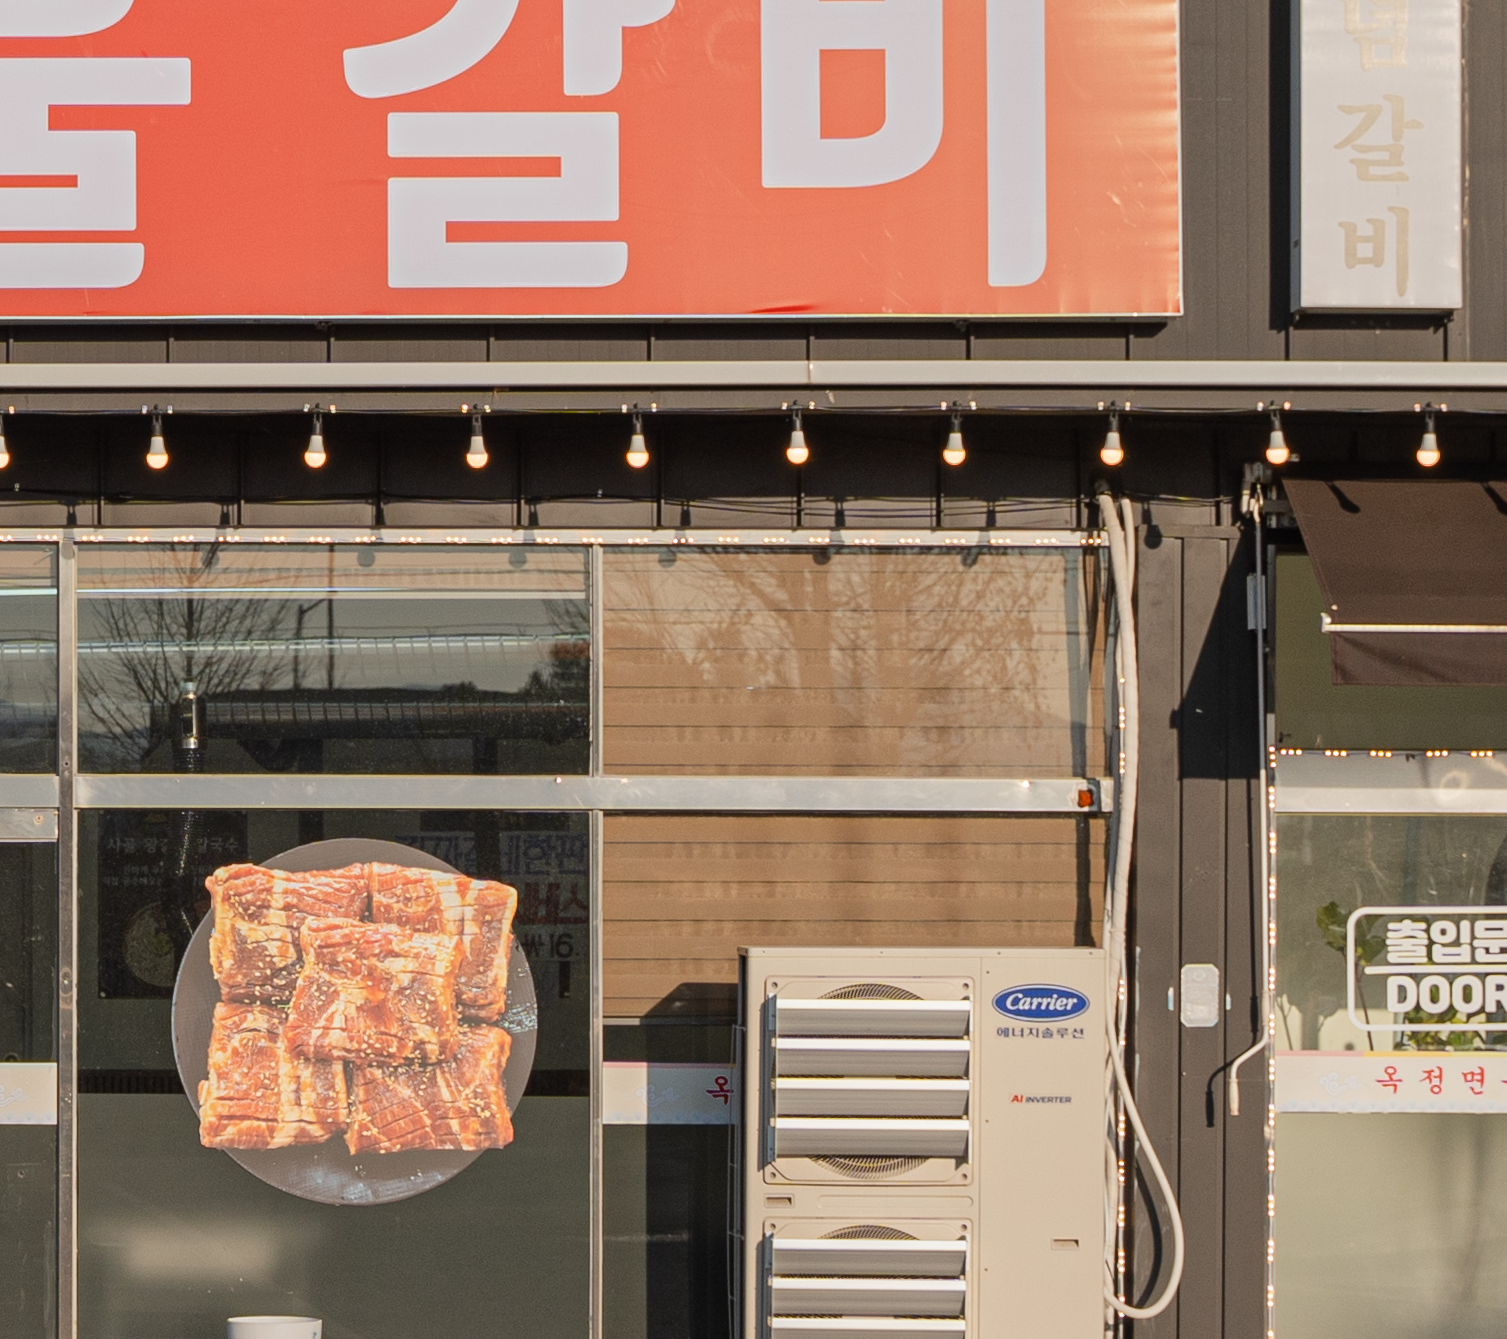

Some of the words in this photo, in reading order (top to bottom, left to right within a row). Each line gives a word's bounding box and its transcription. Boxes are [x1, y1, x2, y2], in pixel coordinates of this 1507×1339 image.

[1005, 992, 1078, 1011] Carrier
[996, 1027, 1085, 1039] 에너지솔루션
[1011, 1094, 1024, 1103] AI
[1025, 1095, 1073, 1104] INVERTER
